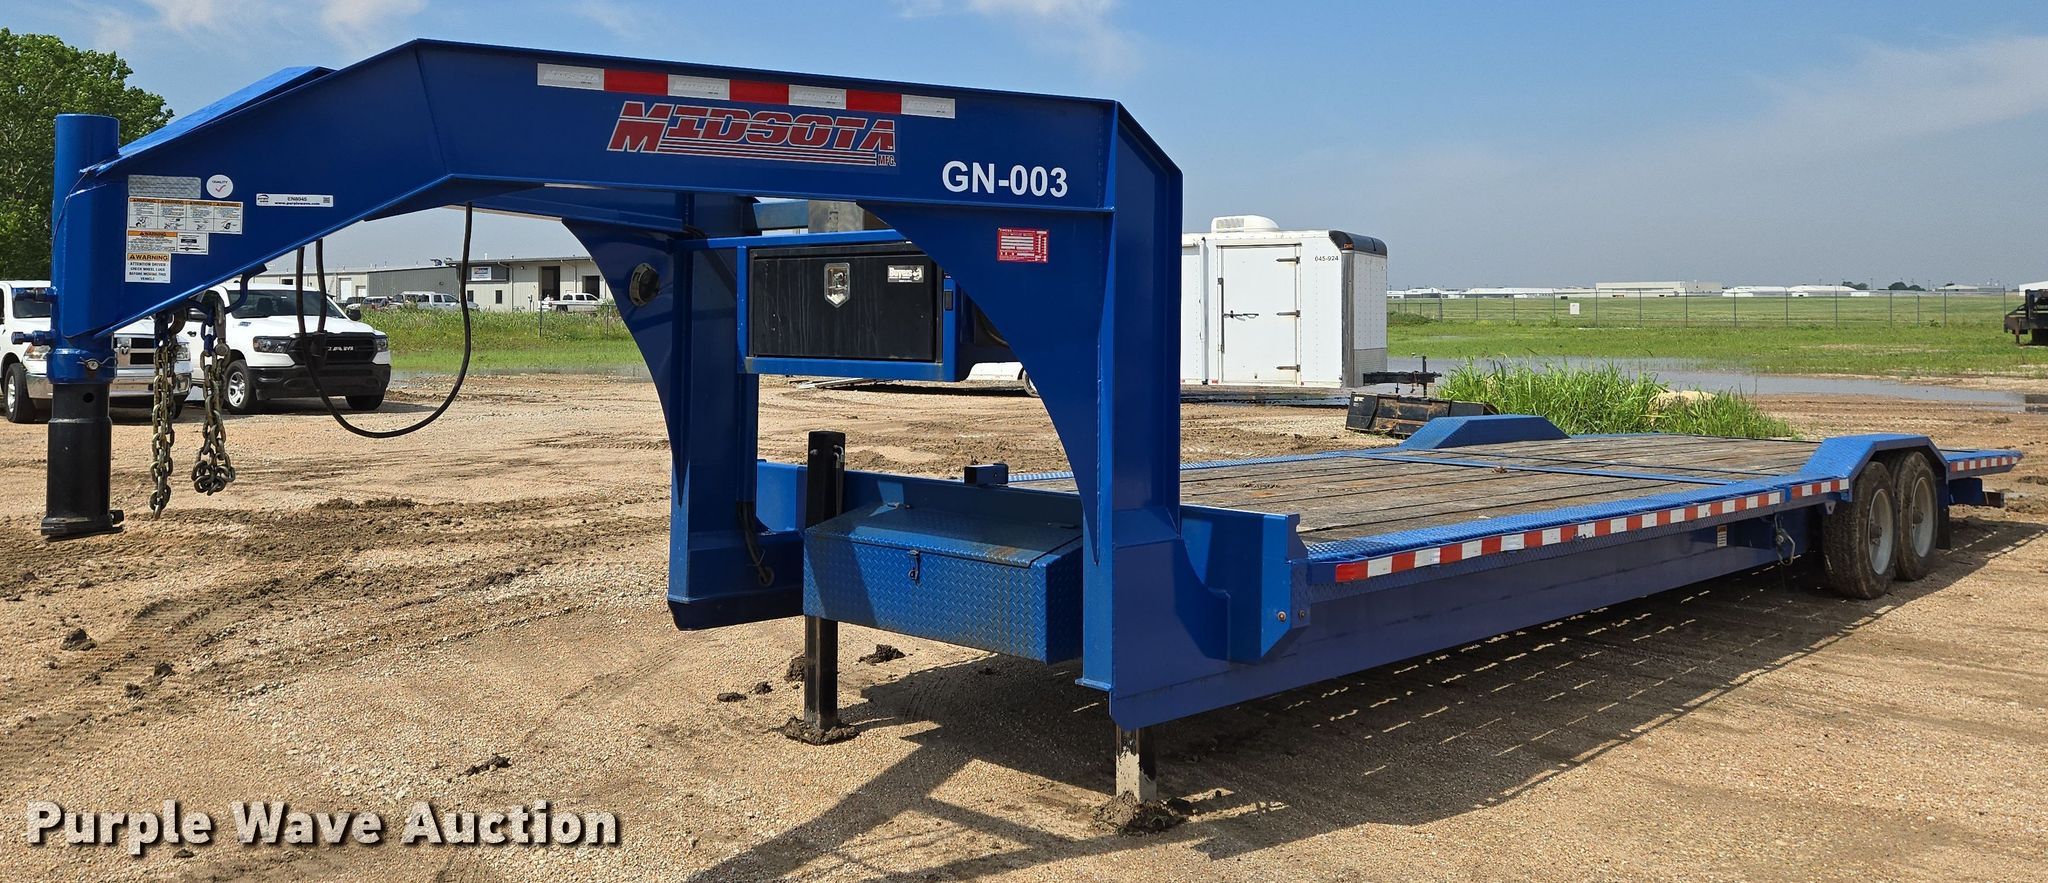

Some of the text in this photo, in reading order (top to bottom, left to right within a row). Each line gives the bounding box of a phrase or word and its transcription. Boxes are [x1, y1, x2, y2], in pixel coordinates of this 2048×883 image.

[606, 100, 896, 153] MIDSOTA
[877, 154, 897, 166] MFG.
[942, 160, 1068, 198] GN-003
[888, 267, 913, 279] Buyers
